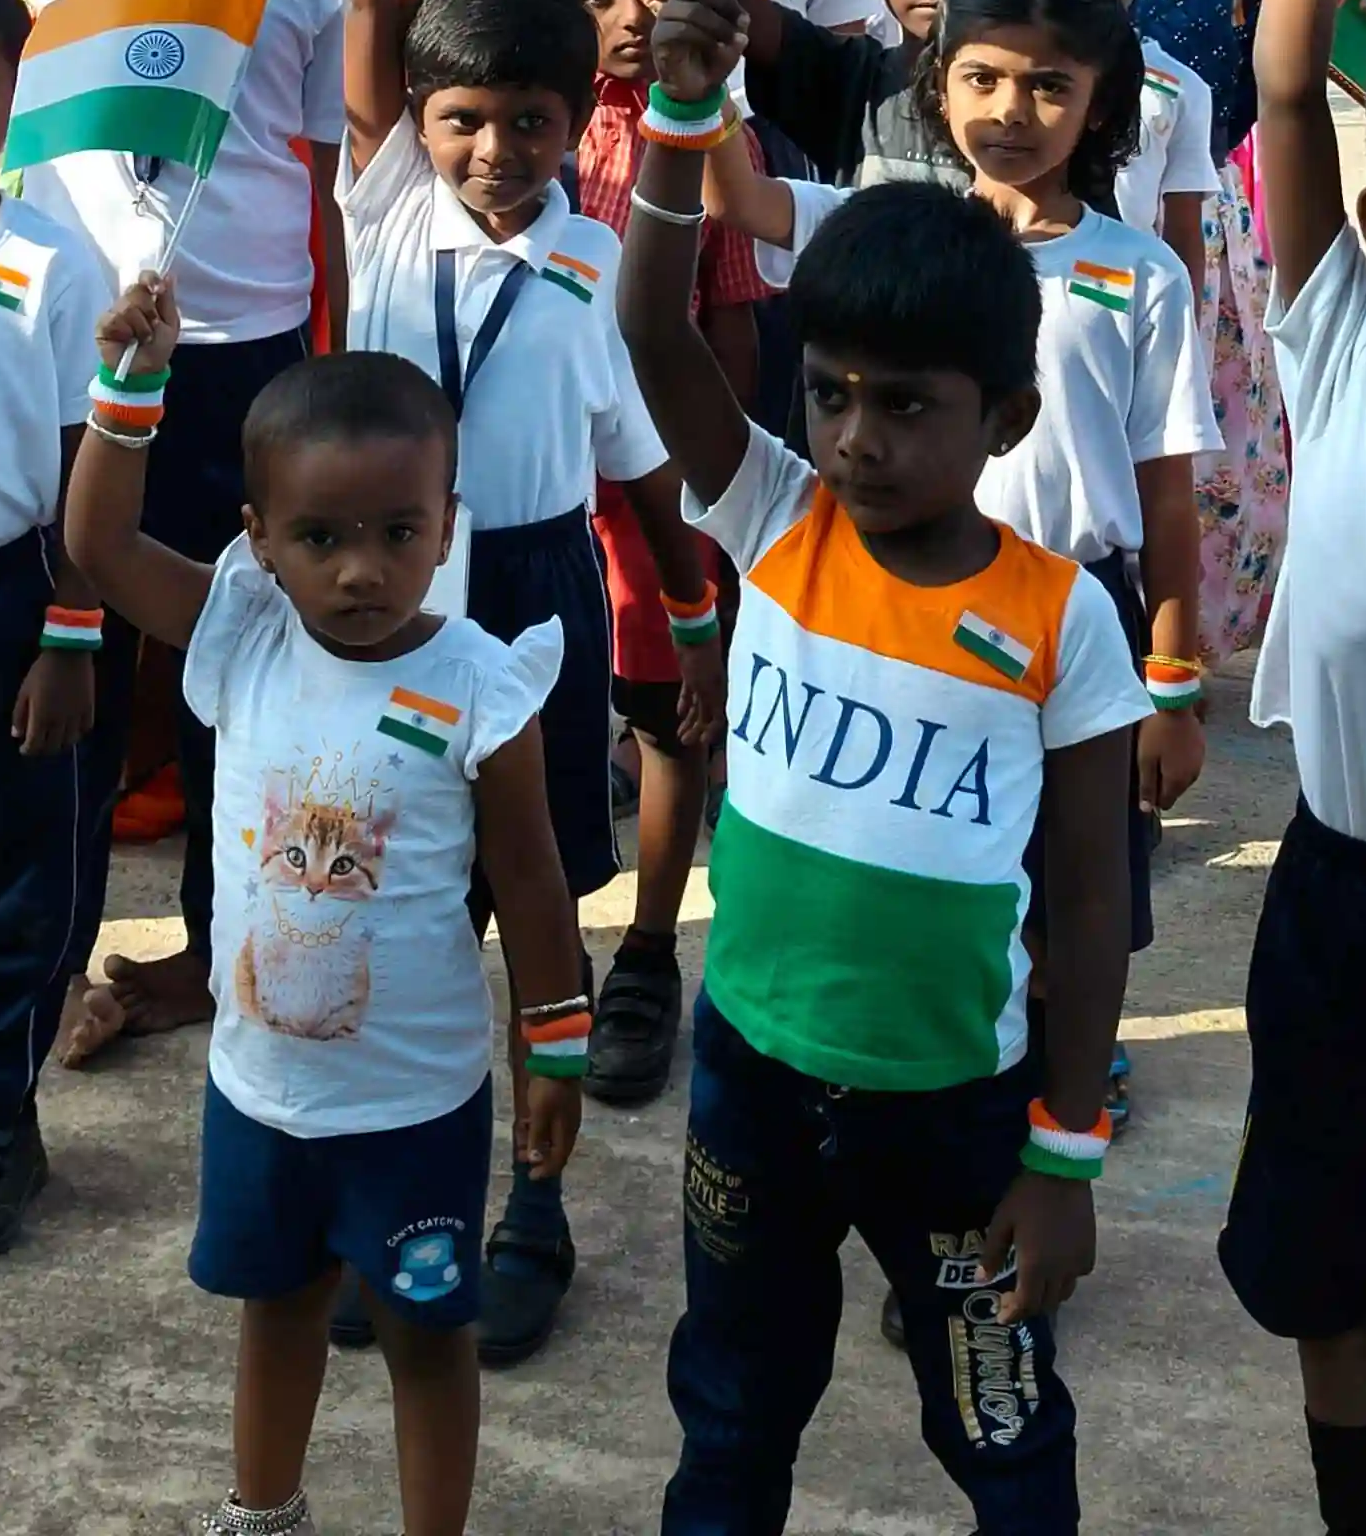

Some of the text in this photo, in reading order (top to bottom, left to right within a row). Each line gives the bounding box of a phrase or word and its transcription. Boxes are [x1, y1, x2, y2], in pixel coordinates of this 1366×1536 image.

[732, 652, 993, 826] INDIA
[690, 1164, 727, 1214] STYLE
[386, 1223, 415, 1248] CAN'T
[416, 1216, 454, 1231] CATCH
